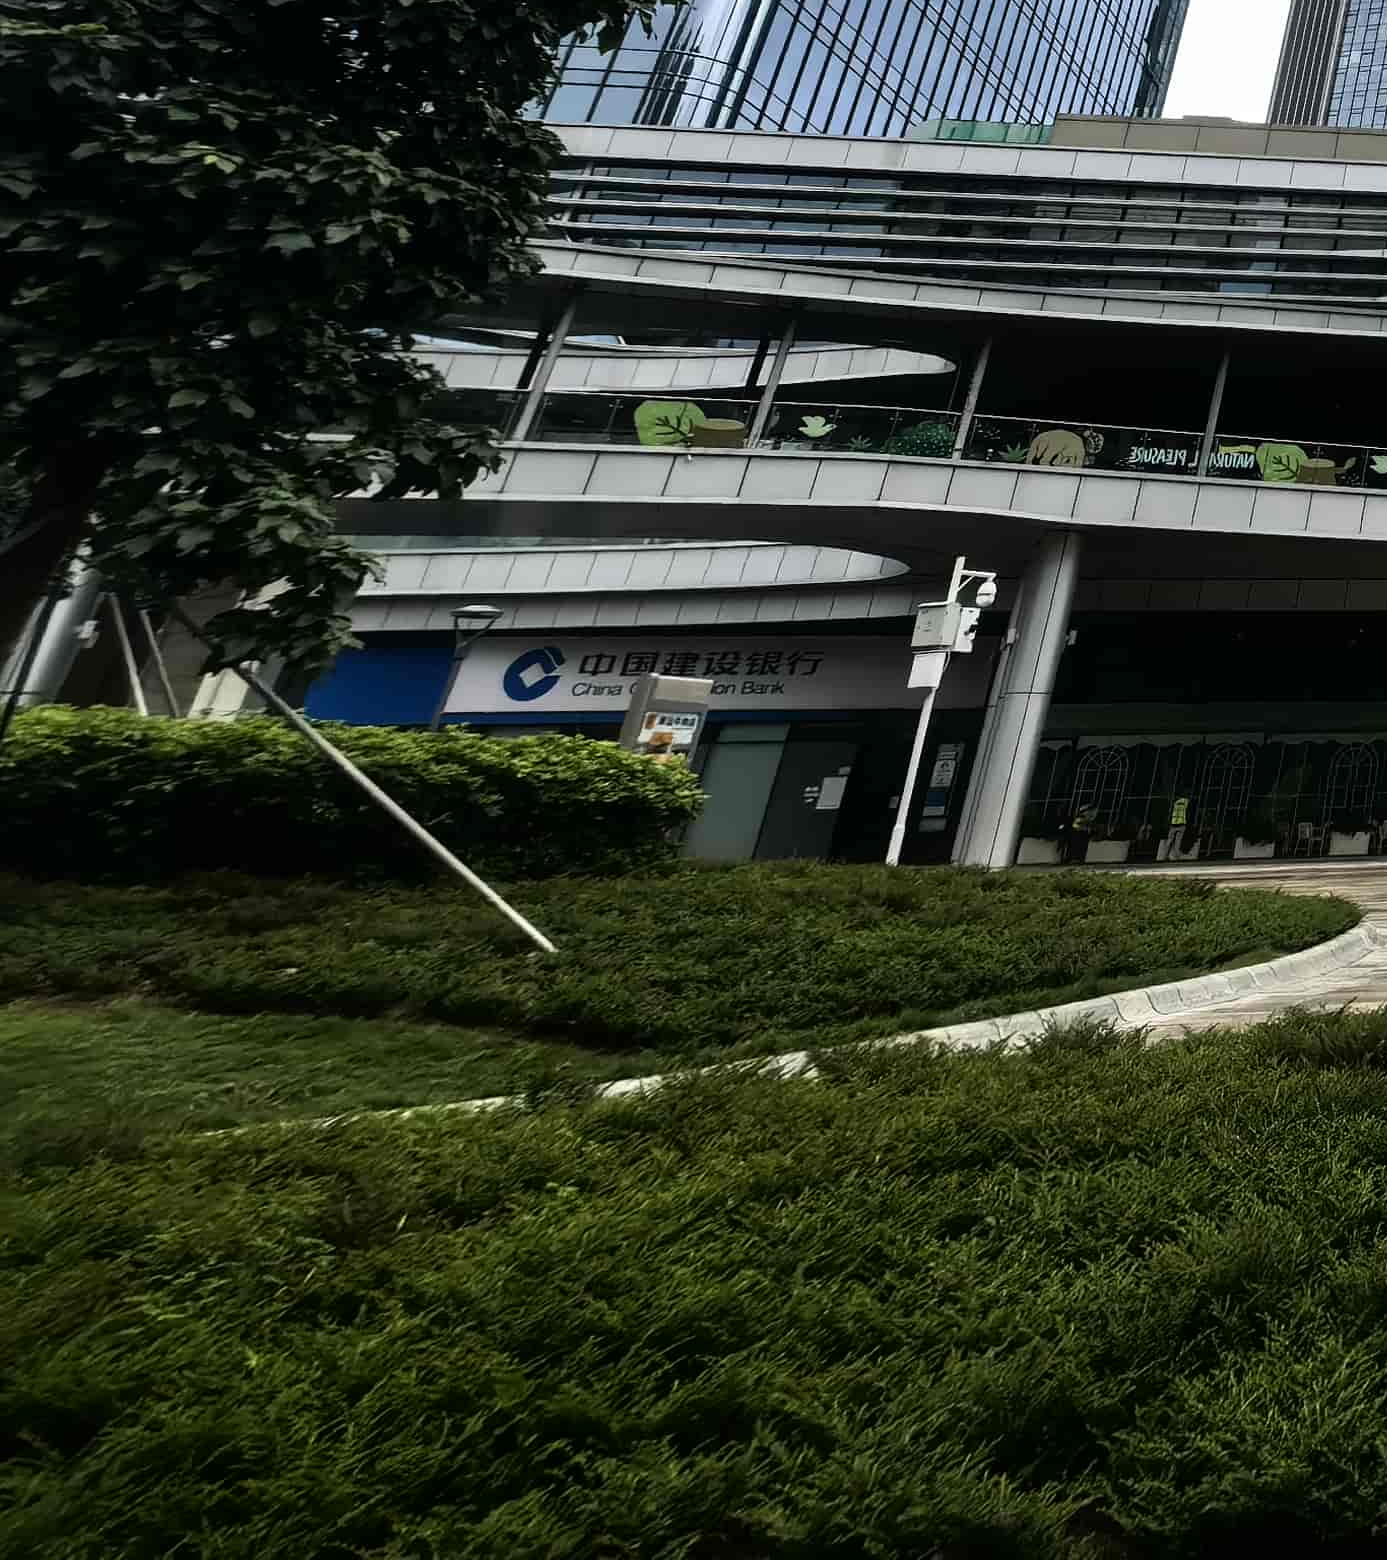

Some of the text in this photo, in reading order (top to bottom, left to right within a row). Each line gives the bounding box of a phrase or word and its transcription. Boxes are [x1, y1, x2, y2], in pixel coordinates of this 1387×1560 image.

[578, 649, 825, 677] 中国建设银行
[571, 681, 622, 697] China
[740, 680, 785, 695] Bank
